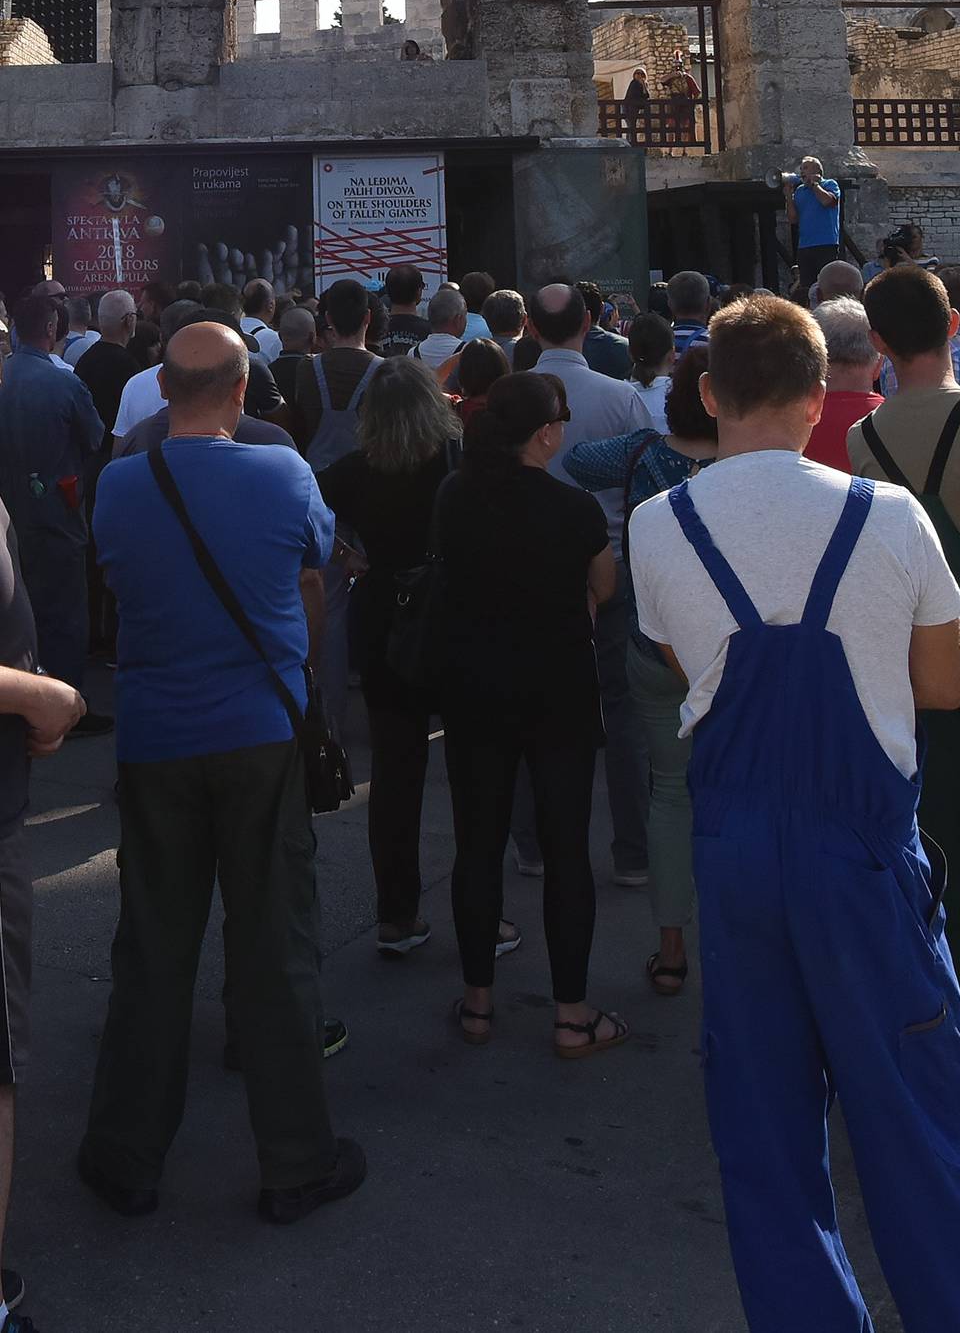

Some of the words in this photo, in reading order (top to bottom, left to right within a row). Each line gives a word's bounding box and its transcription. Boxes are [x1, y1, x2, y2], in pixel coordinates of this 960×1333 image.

[193, 167, 249, 179] Prapovijest
[193, 181, 200, 189] u
[202, 179, 241, 189] rukama
[350, 178, 365, 186] NA
[368, 177, 408, 186] LEĐIMA
[344, 187, 373, 196] PALIH
[376, 186, 415, 195] DIVOVA
[327, 200, 343, 209] ON
[347, 200, 367, 209] THE
[371, 198, 432, 208] SHOULDERS
[332, 210, 346, 219] OF
[350, 209, 385, 219] FALLEN
[388, 208, 427, 218] GIANTS
[74, 259, 159, 271] GLADITORS
